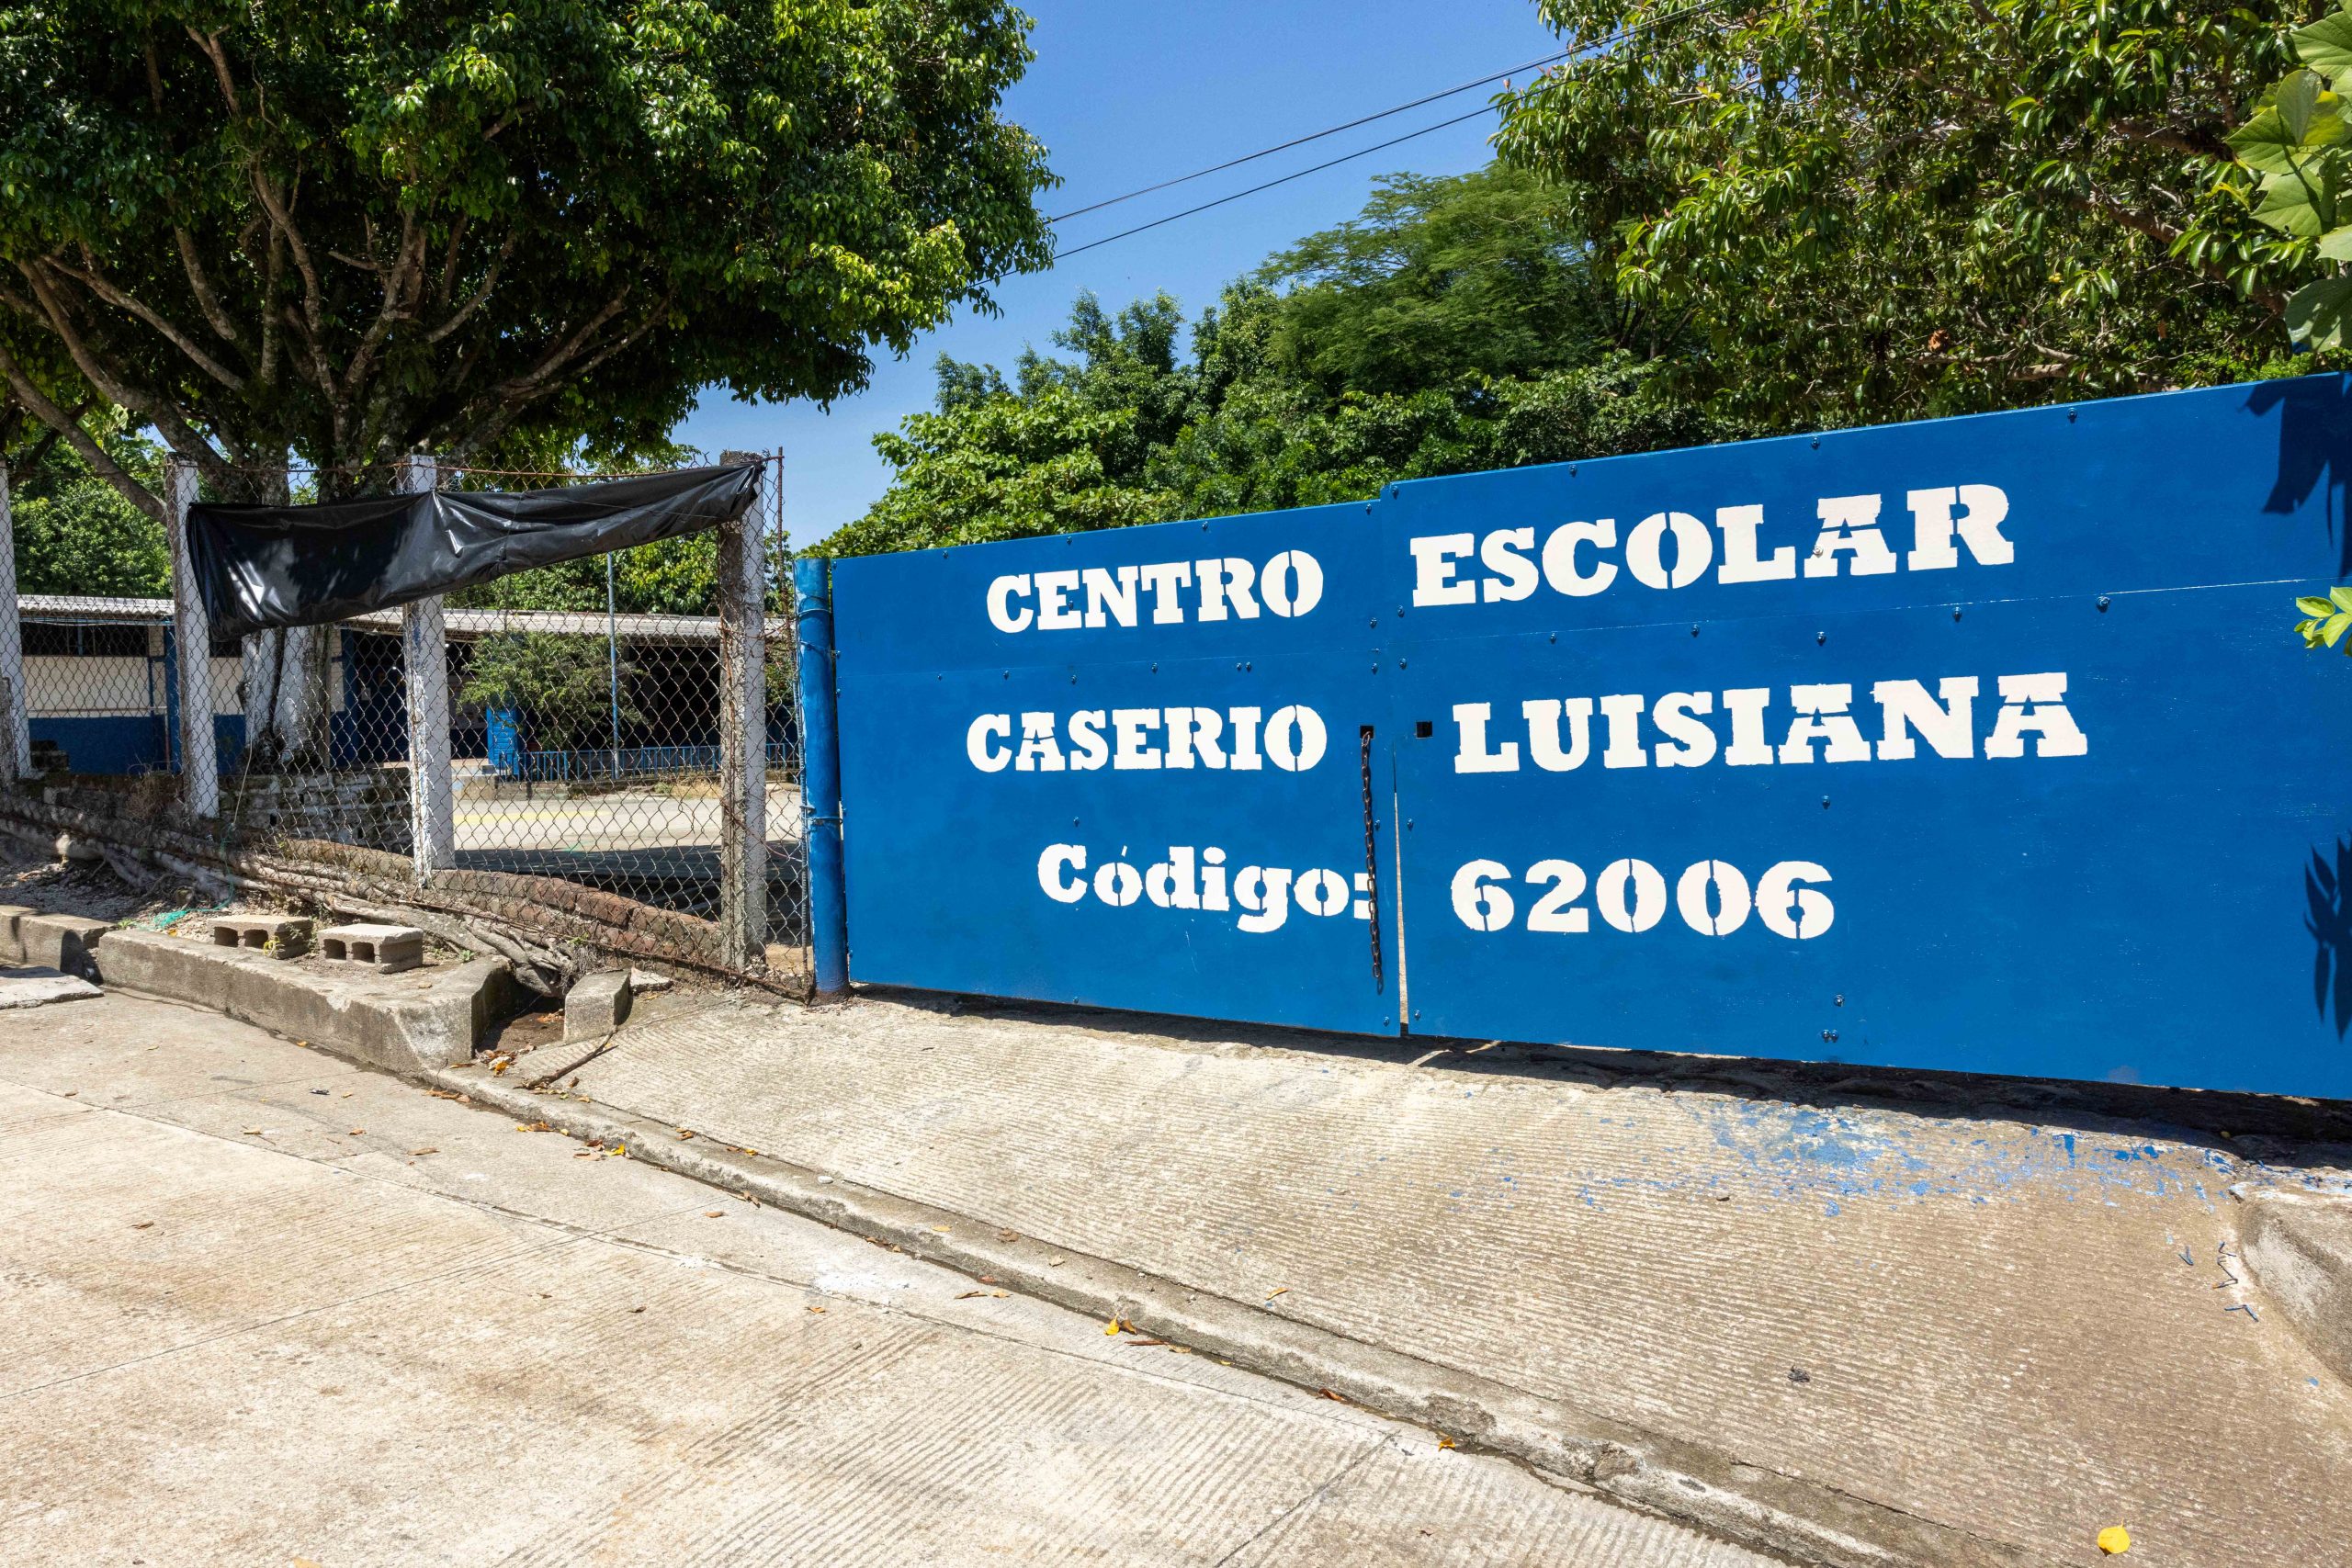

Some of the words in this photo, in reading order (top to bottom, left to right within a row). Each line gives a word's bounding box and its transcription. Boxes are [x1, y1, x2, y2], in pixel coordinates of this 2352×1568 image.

[987, 550, 1323, 633] CENTRO
[1410, 485, 2014, 606] ESCOLAR
[967, 705, 1327, 772] CASERIO
[1453, 672, 2088, 773] LUISIANA
[1038, 843, 1374, 932] Código:
[1451, 859, 1835, 939] 62006
